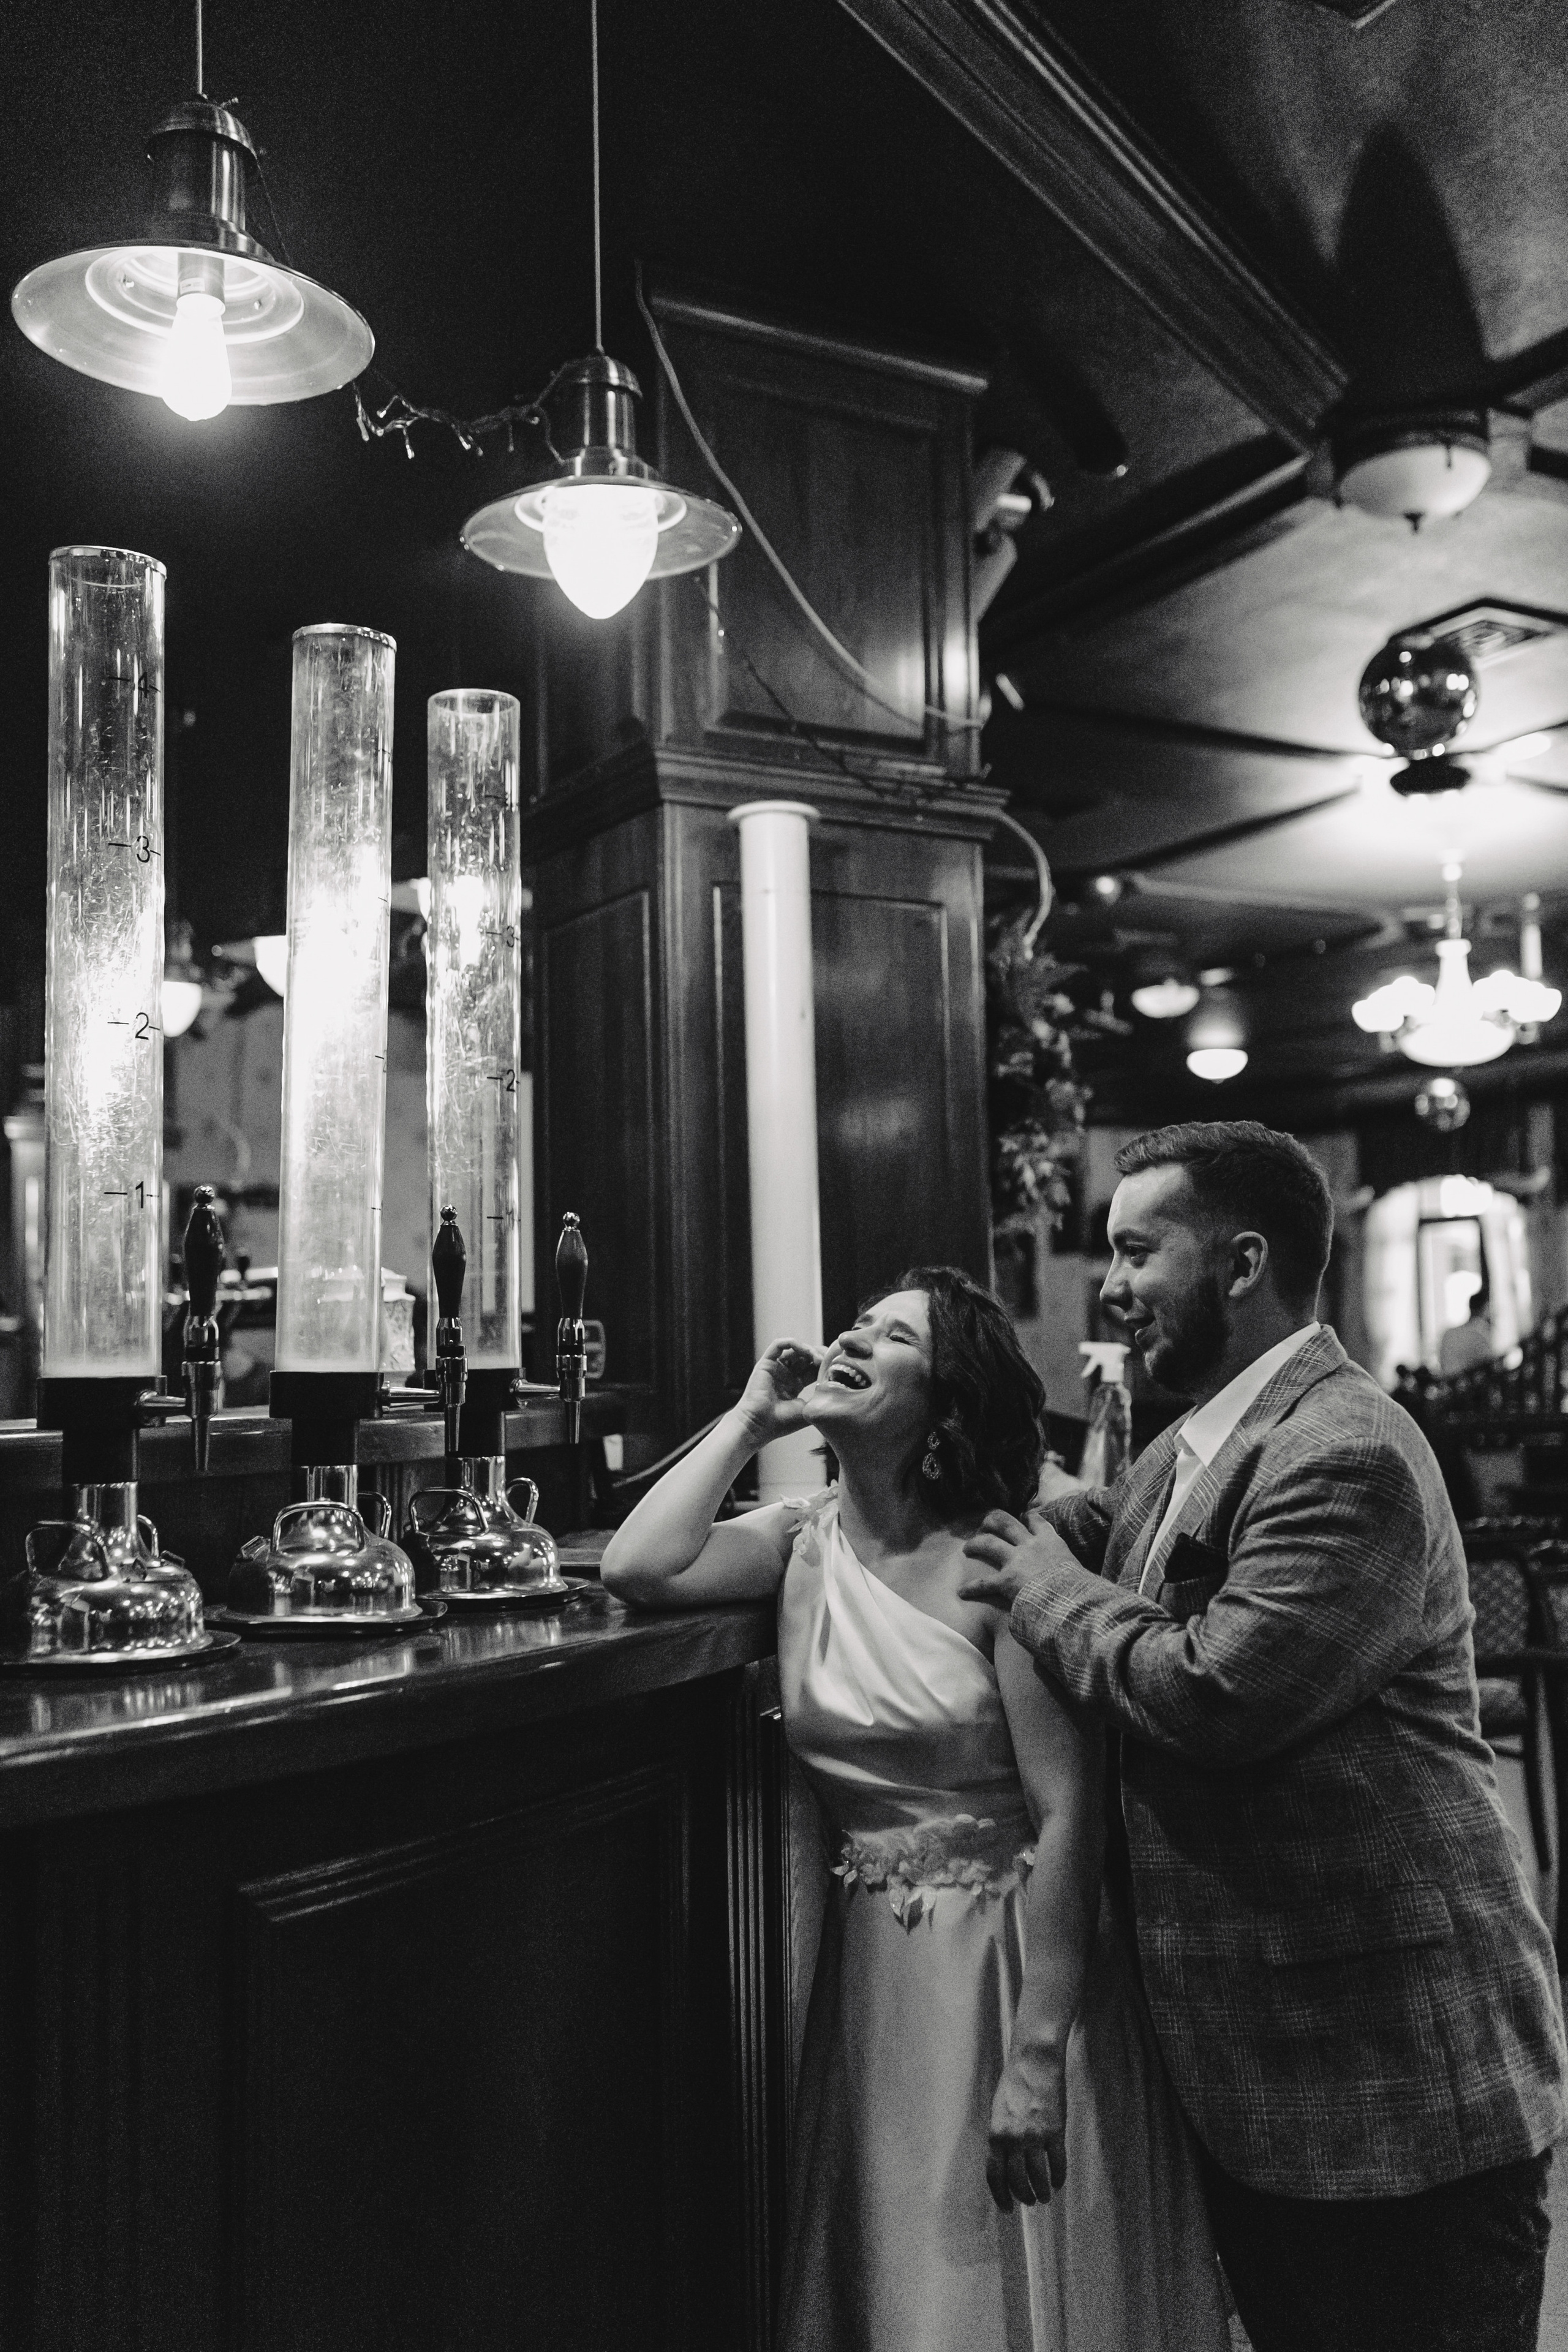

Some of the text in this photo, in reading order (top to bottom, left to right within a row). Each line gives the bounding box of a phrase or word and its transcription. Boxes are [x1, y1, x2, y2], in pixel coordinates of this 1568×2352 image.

[134, 671, 149, 699] 4
[137, 835, 150, 863] 3
[135, 1012, 149, 1040] 2
[507, 1069, 515, 1092] 2
[135, 1181, 143, 1208] 1
